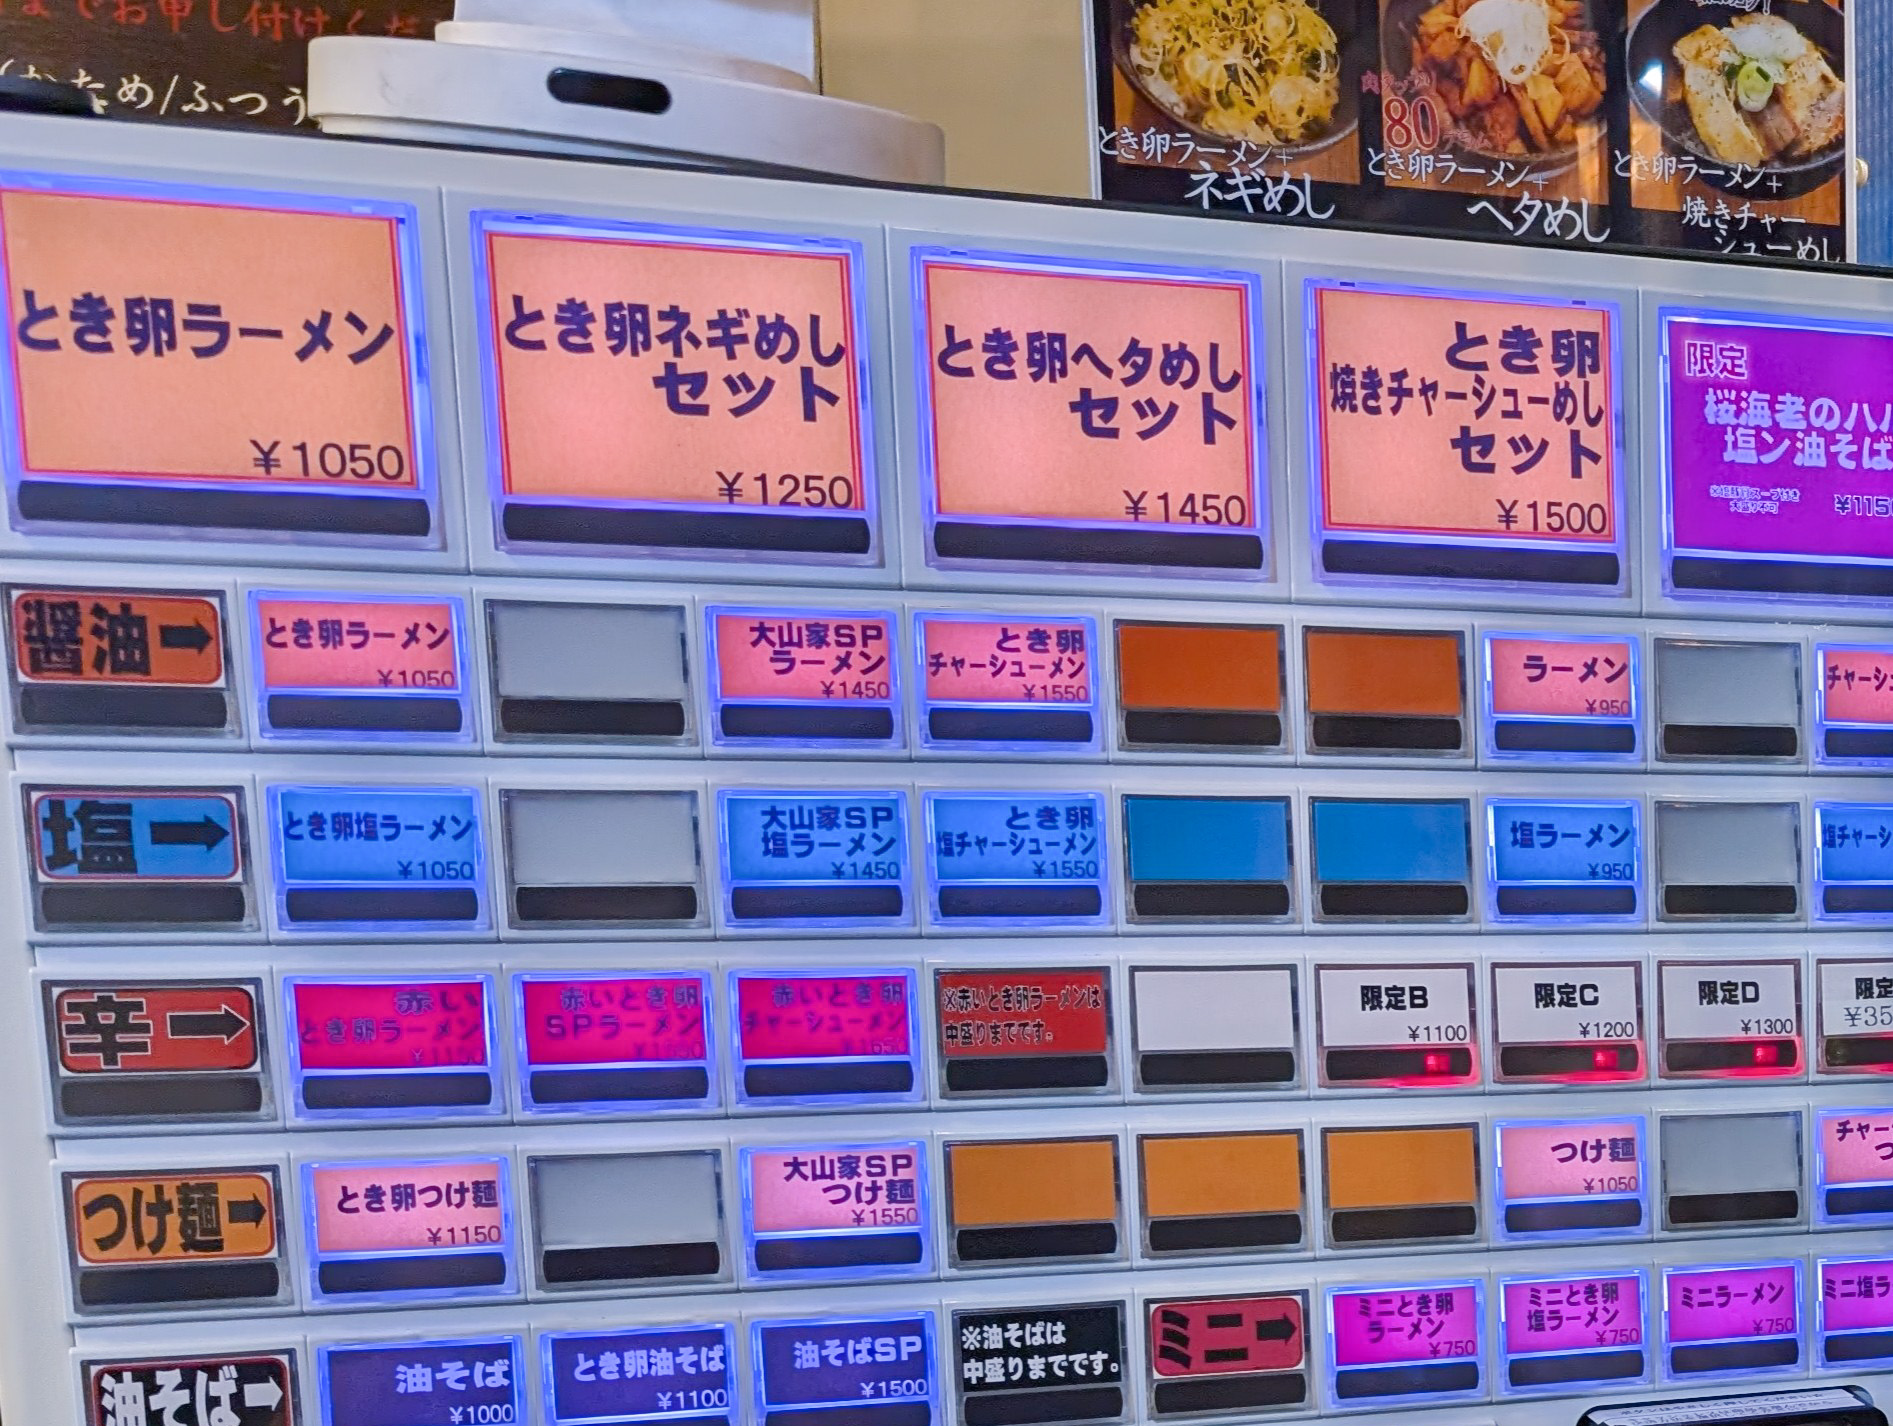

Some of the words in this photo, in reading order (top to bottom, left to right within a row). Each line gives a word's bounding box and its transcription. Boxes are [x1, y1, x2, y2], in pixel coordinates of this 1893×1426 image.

[1384, 95, 1440, 150] 80
[1185, 161, 1335, 220] ネギめし
[1467, 199, 1610, 244] ヘタめし
[1682, 196, 1806, 233] 焼きチャー
[16, 290, 395, 364] とき卵ラーメン
[505, 295, 845, 366] とき卵ネギめし
[937, 325, 1242, 394] とき卵ヘタめし
[1445, 321, 1600, 378] とき卵
[1685, 340, 1747, 380] 限定
[1330, 362, 1604, 428] 焼きチャーシューめし
[1069, 387, 1237, 445] セット
[250, 439, 405, 481] ¥1050
[1450, 423, 1602, 479] セット
[717, 471, 853, 508] ¥1250
[1123, 490, 1246, 527] ¥1450
[1497, 499, 1607, 534] ¥1500
[23, 599, 151, 676] 醤油
[265, 617, 450, 652] とき卵ラーメン
[750, 623, 884, 650] 大山家SP
[997, 628, 1085, 654] とき卵
[770, 651, 886, 676] ラーメン
[929, 652, 1085, 679] チャーシューメン
[1523, 655, 1628, 683] ラーメン
[284, 810, 473, 842] とき卵塩ラーメン
[761, 805, 893, 832] 大山家SP
[1006, 806, 1093, 832] とき卵
[42, 799, 137, 874] 塩
[936, 830, 1096, 857] 塩チャーシューメン
[1510, 821, 1630, 849] 塩ラーメン
[1588, 862, 1632, 880] ¥950
[393, 989, 481, 1015] 赤い
[560, 984, 699, 1012] 赤いとき卵
[944, 985, 1101, 1011] ※赤いとき卵ラーメンは
[1360, 984, 1429, 1012] 限定B
[1534, 982, 1600, 1009] 限定C
[1698, 979, 1760, 1005] 限定D
[61, 993, 152, 1067] 辛
[546, 1014, 700, 1039] SPラーメン
[1407, 1023, 1467, 1043] ¥1100
[1578, 1020, 1635, 1039] ¥1200
[1740, 1017, 1794, 1036] ¥1300
[1551, 1136, 1636, 1164] つけ麺
[783, 1153, 914, 1183] 大山家SP
[336, 1179, 499, 1215] とき卵つけ麺
[852, 1207, 919, 1226] ¥1550
[427, 1224, 501, 1246] ¥1150
[1528, 1281, 1619, 1308] ミニとき卵
[1681, 1281, 1785, 1309] ミニラーメン
[961, 1321, 1066, 1349] ※油そばは
[1158, 1309, 1249, 1370] ミニ
[572, 1344, 725, 1383] とき卵油そば
[794, 1335, 922, 1370] 油そばSP
[395, 1359, 512, 1395] 油そば
[963, 1351, 1119, 1385] 中盛りまでです。
[658, 1388, 728, 1410] ¥1100
[860, 1378, 928, 1398] ¥1500
[449, 1404, 514, 1426] ¥1000
